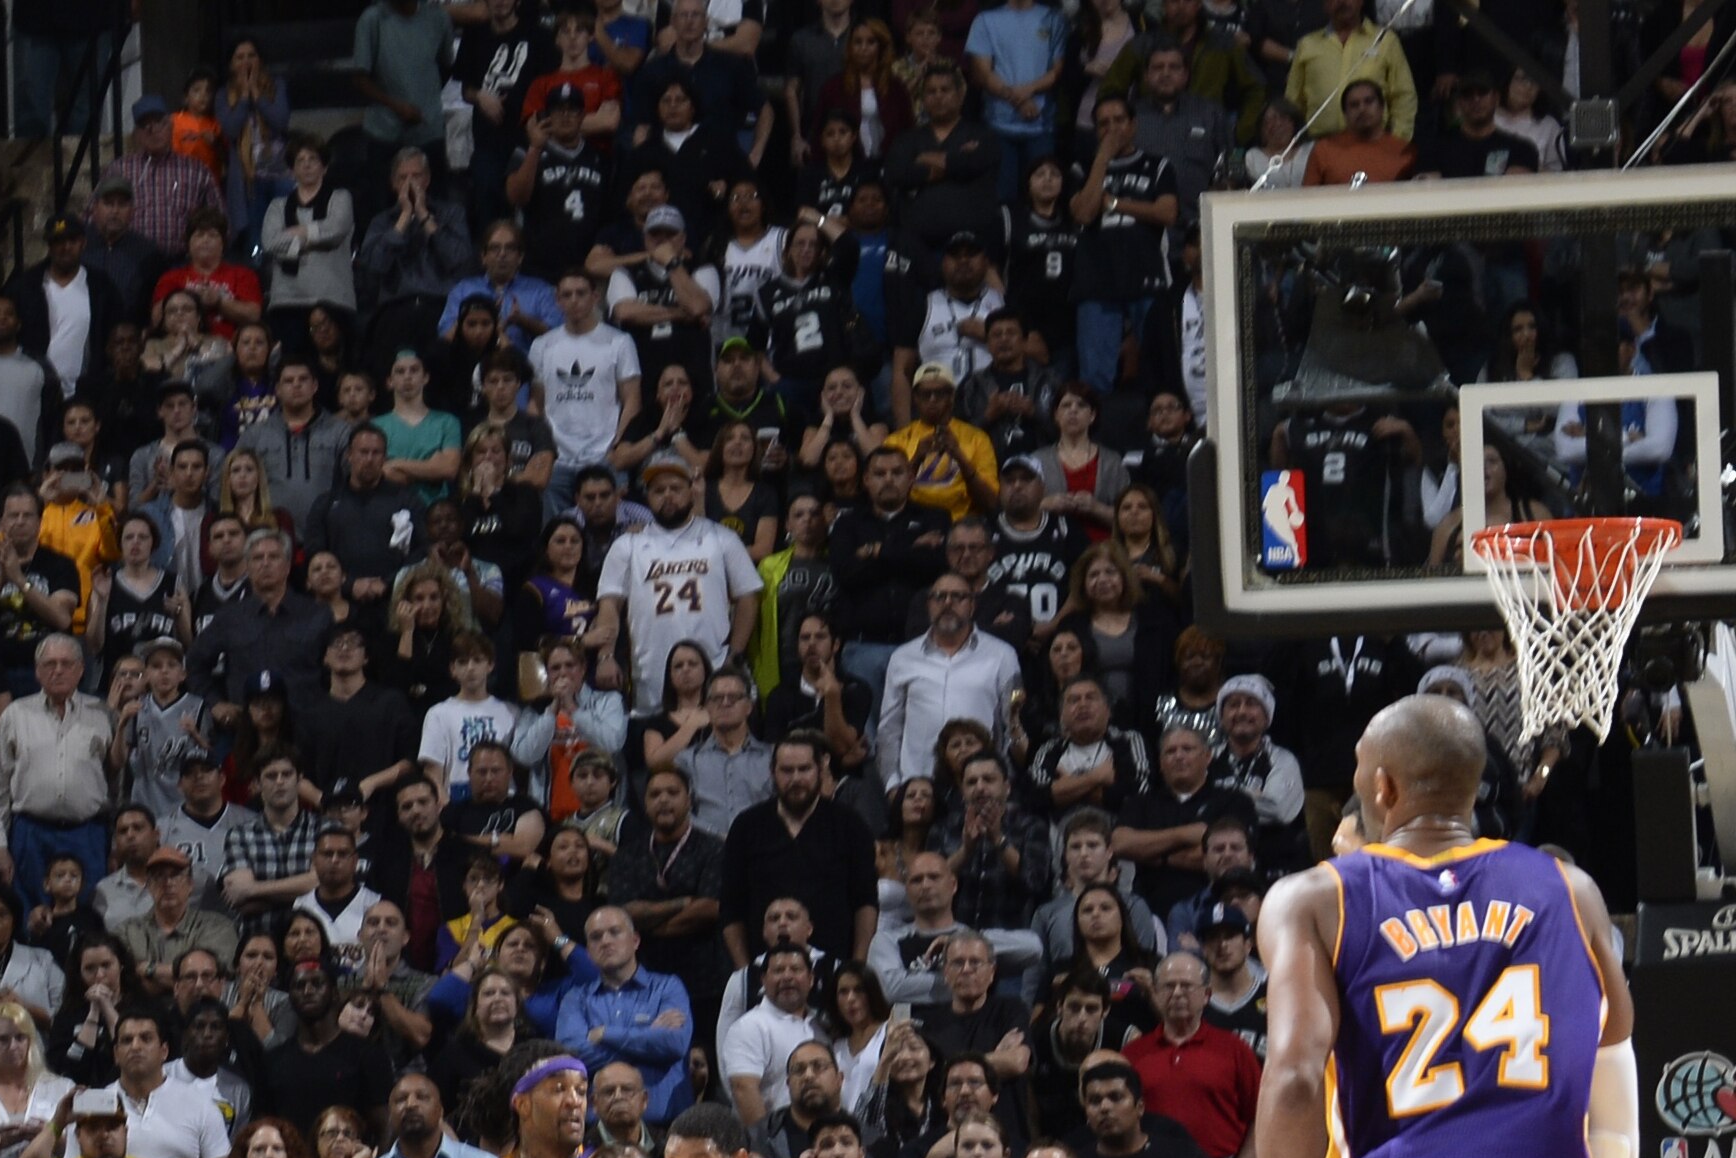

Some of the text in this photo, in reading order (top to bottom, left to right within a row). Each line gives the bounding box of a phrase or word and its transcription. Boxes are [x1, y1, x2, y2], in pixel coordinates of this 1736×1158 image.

[563, 188, 585, 219] 4
[794, 311, 823, 353] 2
[1323, 450, 1346, 484] 2
[644, 558, 711, 583] LAKERS
[1266, 544, 1294, 567] NBA
[652, 579, 702, 617] 24
[1378, 899, 1536, 963] BRYANT
[1373, 962, 1550, 1119] 24
